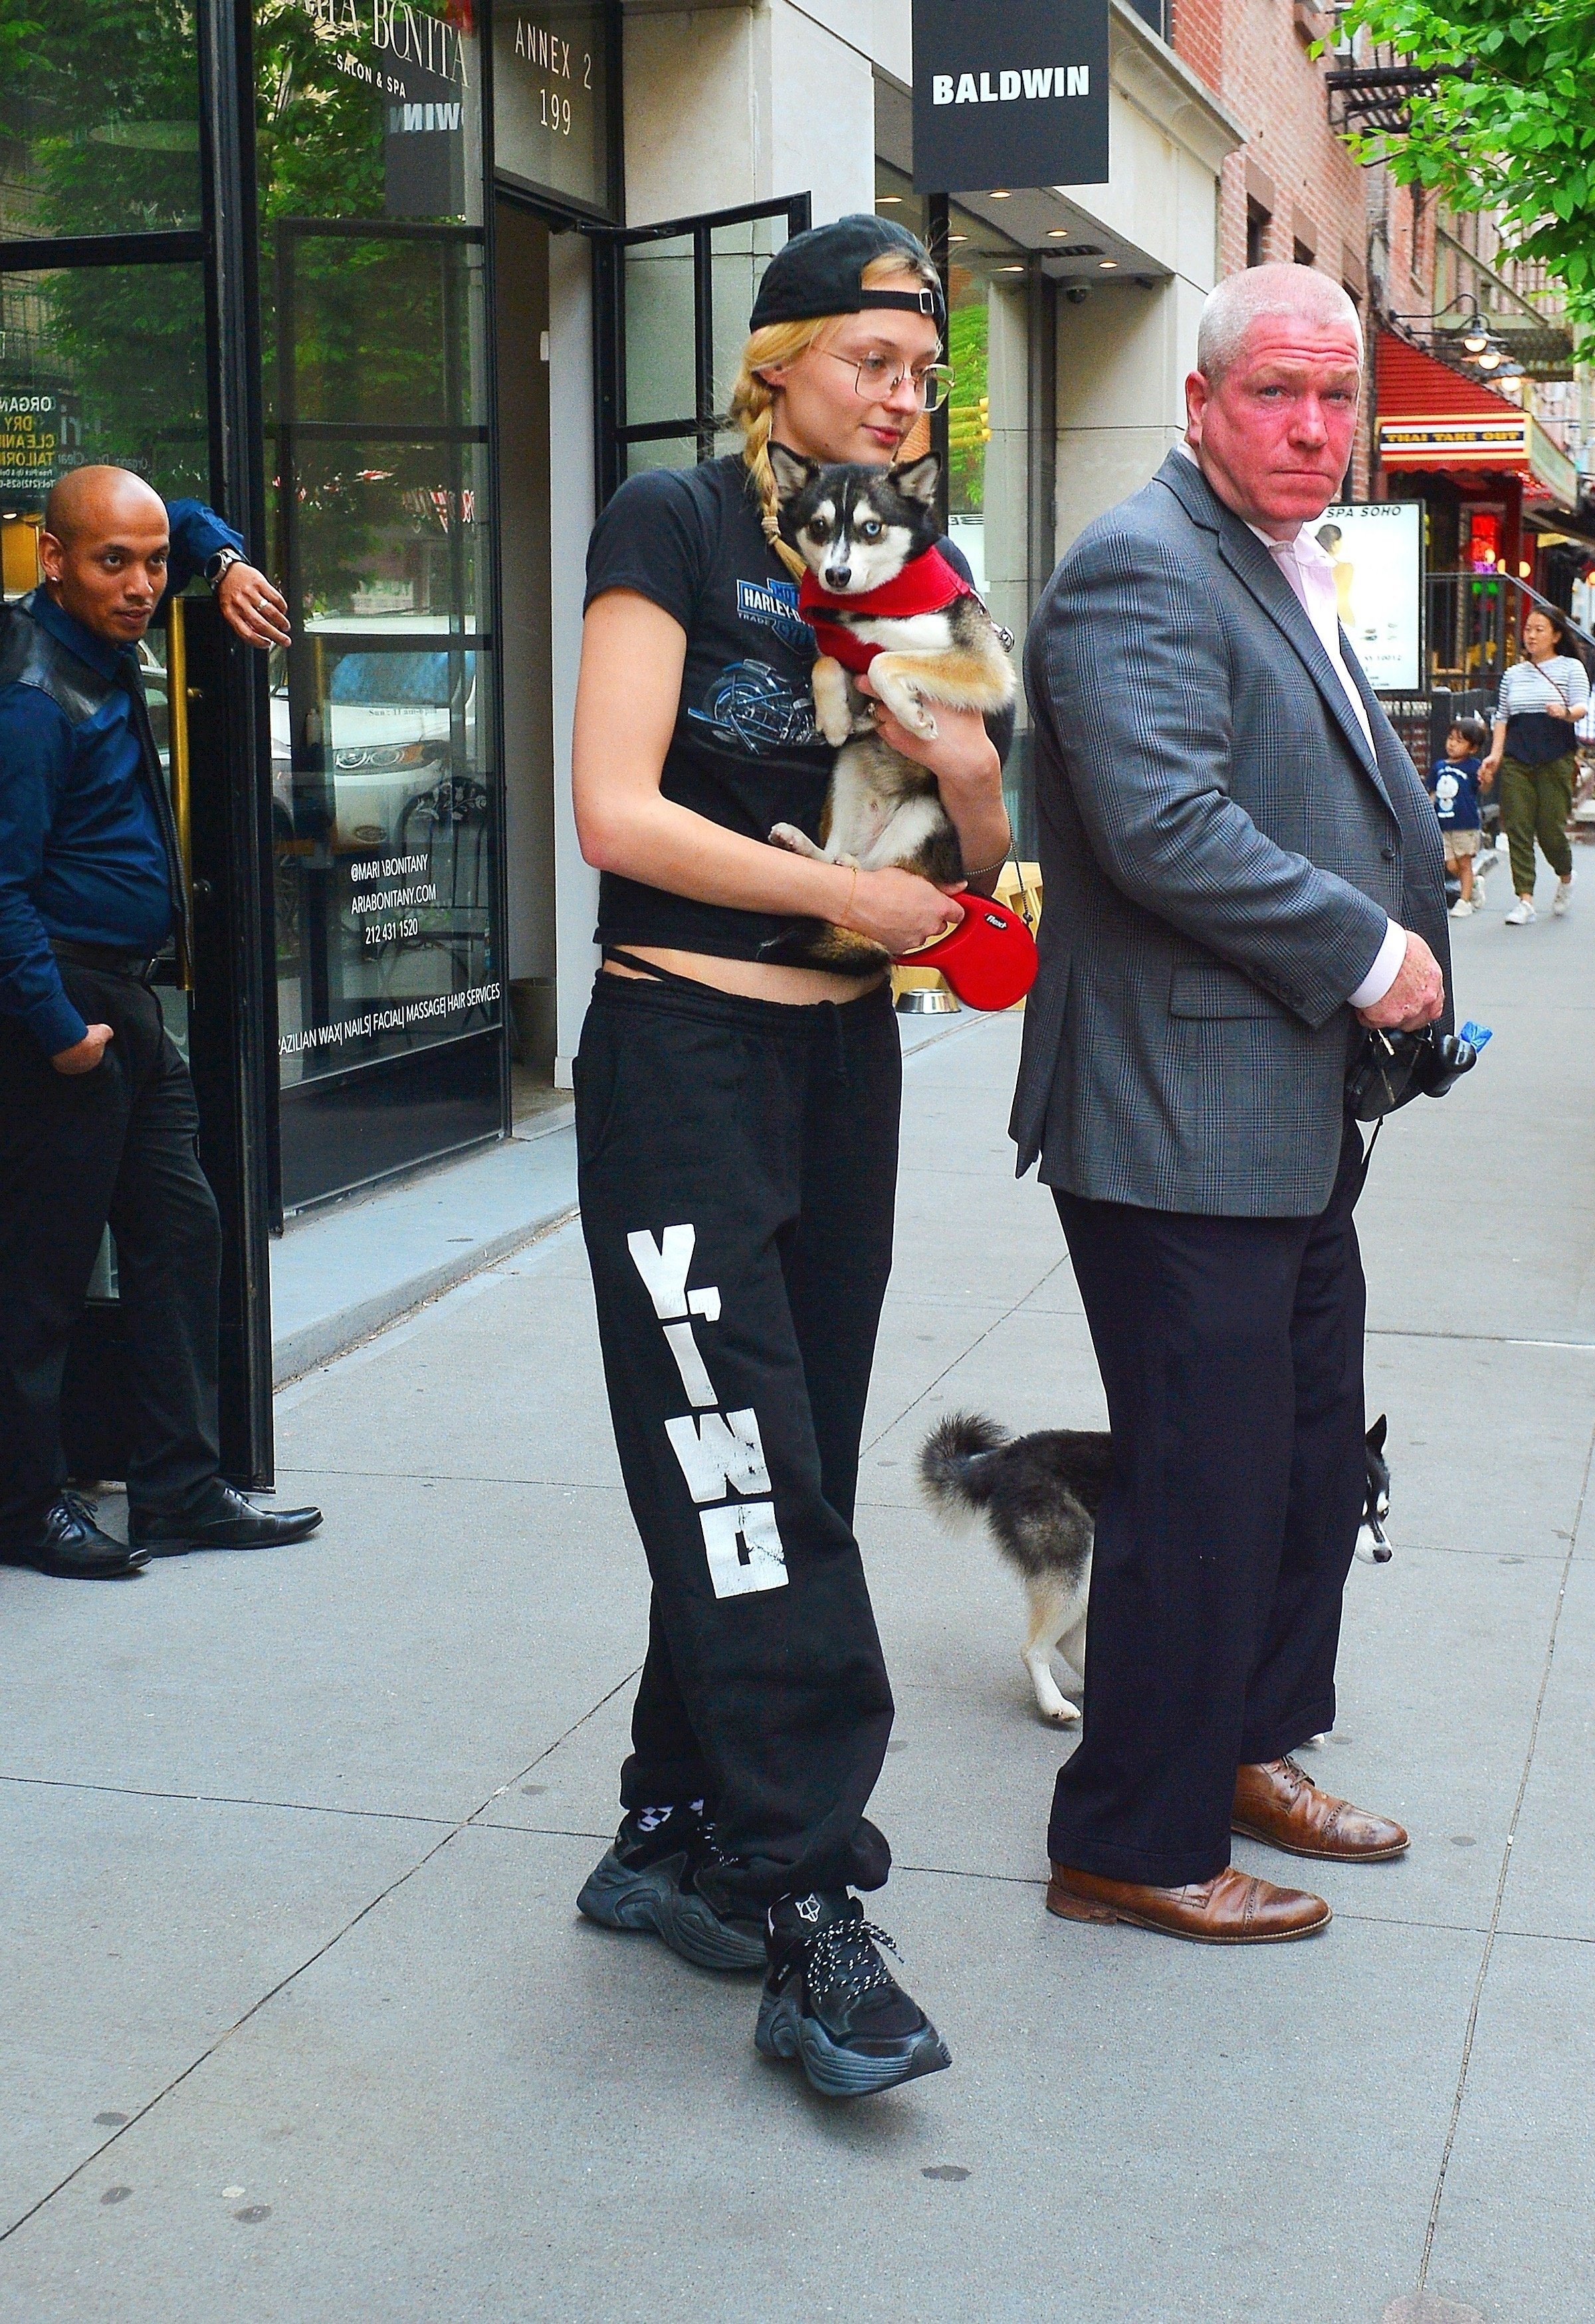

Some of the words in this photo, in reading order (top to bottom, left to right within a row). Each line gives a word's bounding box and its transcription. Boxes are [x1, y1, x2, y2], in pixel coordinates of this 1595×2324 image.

[371, 0, 470, 88] BONITA
[515, 17, 570, 80] ANNEX
[584, 53, 591, 90] 2
[336, 53, 373, 84] SALON
[376, 72, 383, 88] &
[387, 74, 407, 99] SPA
[932, 65, 1090, 106] BALDWIN
[540, 88, 572, 136] 199
[1386, 433, 1428, 442] THAI
[1433, 432, 1475, 441] TAKE
[1481, 431, 1519, 440] OUT
[1326, 508, 1354, 518] SPA
[1360, 507, 1402, 517] SOHO
[351, 883, 437, 915] ARIABONITANY.COM
[366, 925, 381, 945] 212
[382, 922, 396, 941] 431
[399, 917, 418, 938] 1520
[447, 995, 465, 1012] HAIR
[467, 983, 500, 1007] SERVICES
